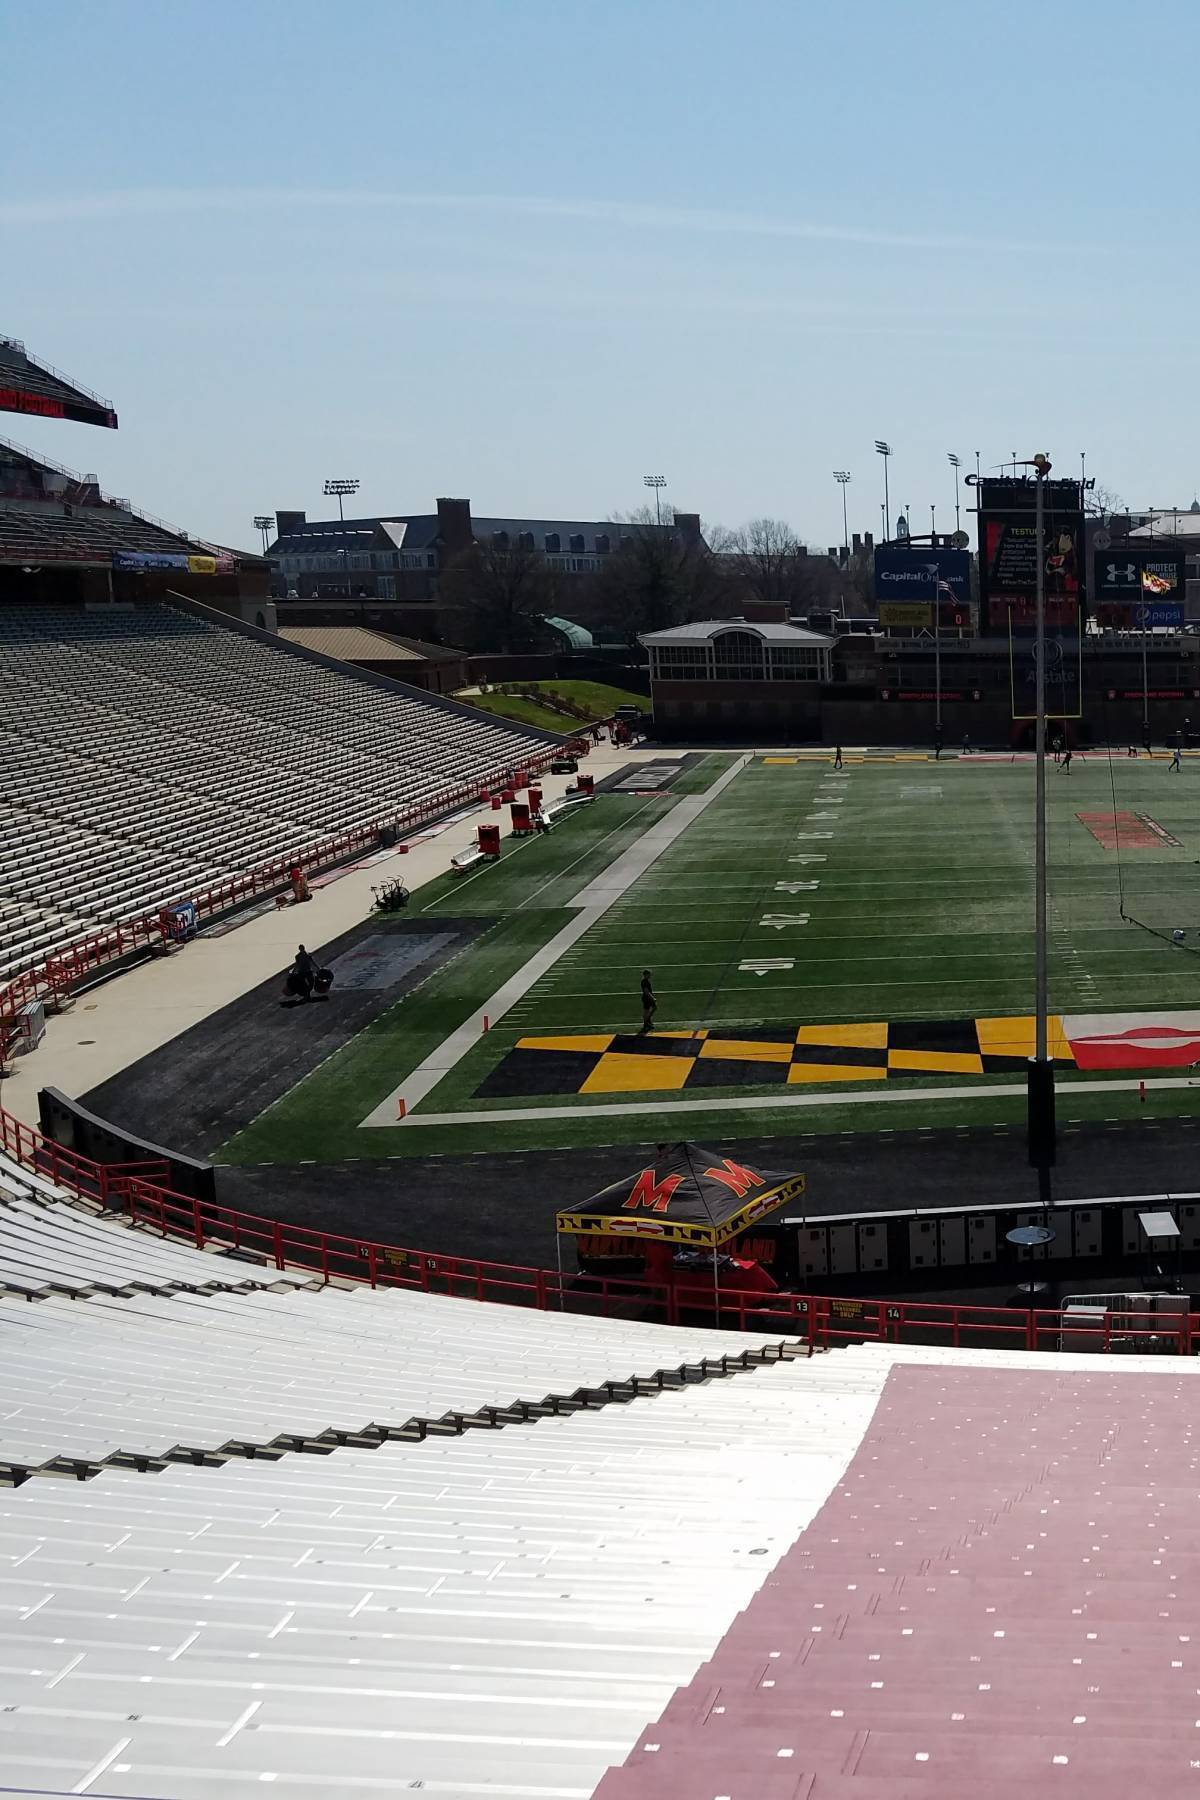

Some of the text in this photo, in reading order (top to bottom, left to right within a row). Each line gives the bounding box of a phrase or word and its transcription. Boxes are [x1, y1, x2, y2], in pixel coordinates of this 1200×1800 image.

[1146, 563, 1178, 573] PROTECT
[1152, 610, 1181, 623] pepsi
[703, 1158, 767, 1199] M
[621, 1169, 687, 1213] M
[360, 1248, 369, 1257] 12
[427, 1260, 437, 1269] 13
[796, 1302, 809, 1312] 13
[887, 1309, 900, 1319] 14
